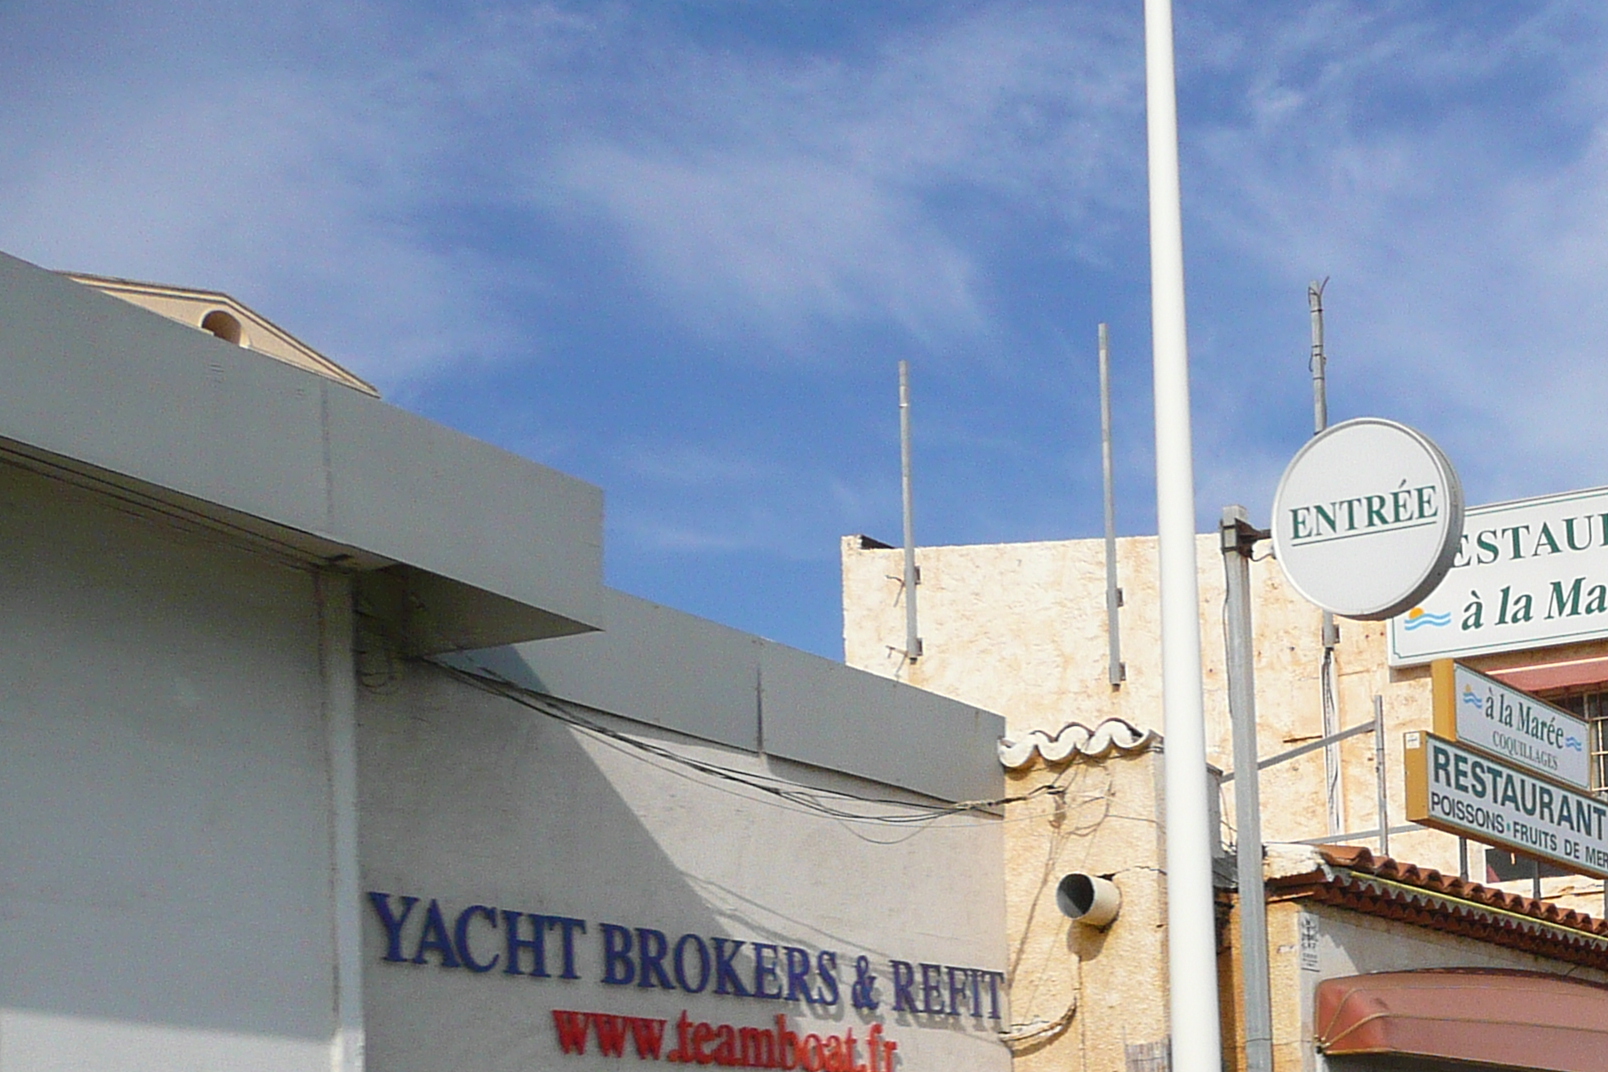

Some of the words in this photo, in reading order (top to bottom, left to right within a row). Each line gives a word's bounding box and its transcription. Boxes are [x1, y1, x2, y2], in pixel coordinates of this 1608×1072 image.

[1289, 478, 1439, 540] ENTRÉE
[1460, 590, 1485, 632] à
[1494, 585, 1533, 626] la
[1484, 687, 1495, 719] à
[1498, 693, 1514, 728] la
[1518, 701, 1565, 750] Marée
[1492, 730, 1559, 771] COQUILLAGES
[1432, 745, 1608, 841] RESTAURANT
[1431, 791, 1505, 834] POISSONS
[1513, 820, 1557, 852] FRUITS
[1564, 838, 1581, 860] DE
[367, 891, 587, 981] YACHT
[599, 922, 840, 1007] BROKERS
[851, 955, 881, 1010] &
[888, 959, 1005, 1020] REFIT
